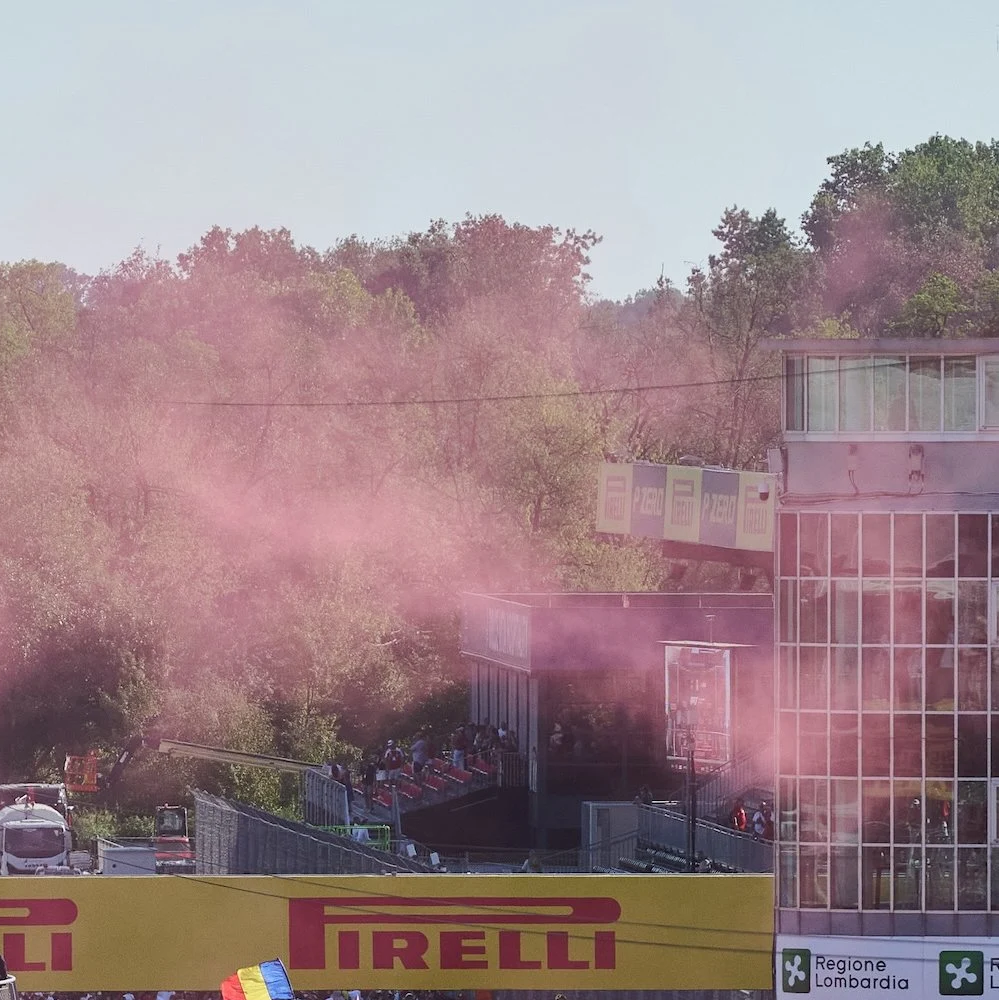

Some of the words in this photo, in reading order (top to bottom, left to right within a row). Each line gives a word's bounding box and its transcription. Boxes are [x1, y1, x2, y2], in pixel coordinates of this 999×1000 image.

[639, 487, 665, 516] ZERO
[709, 494, 737, 524] ZERO
[289, 897, 621, 970] PIRELLI
[815, 956, 887, 974] Regione
[815, 974, 909, 990] Lombardia
